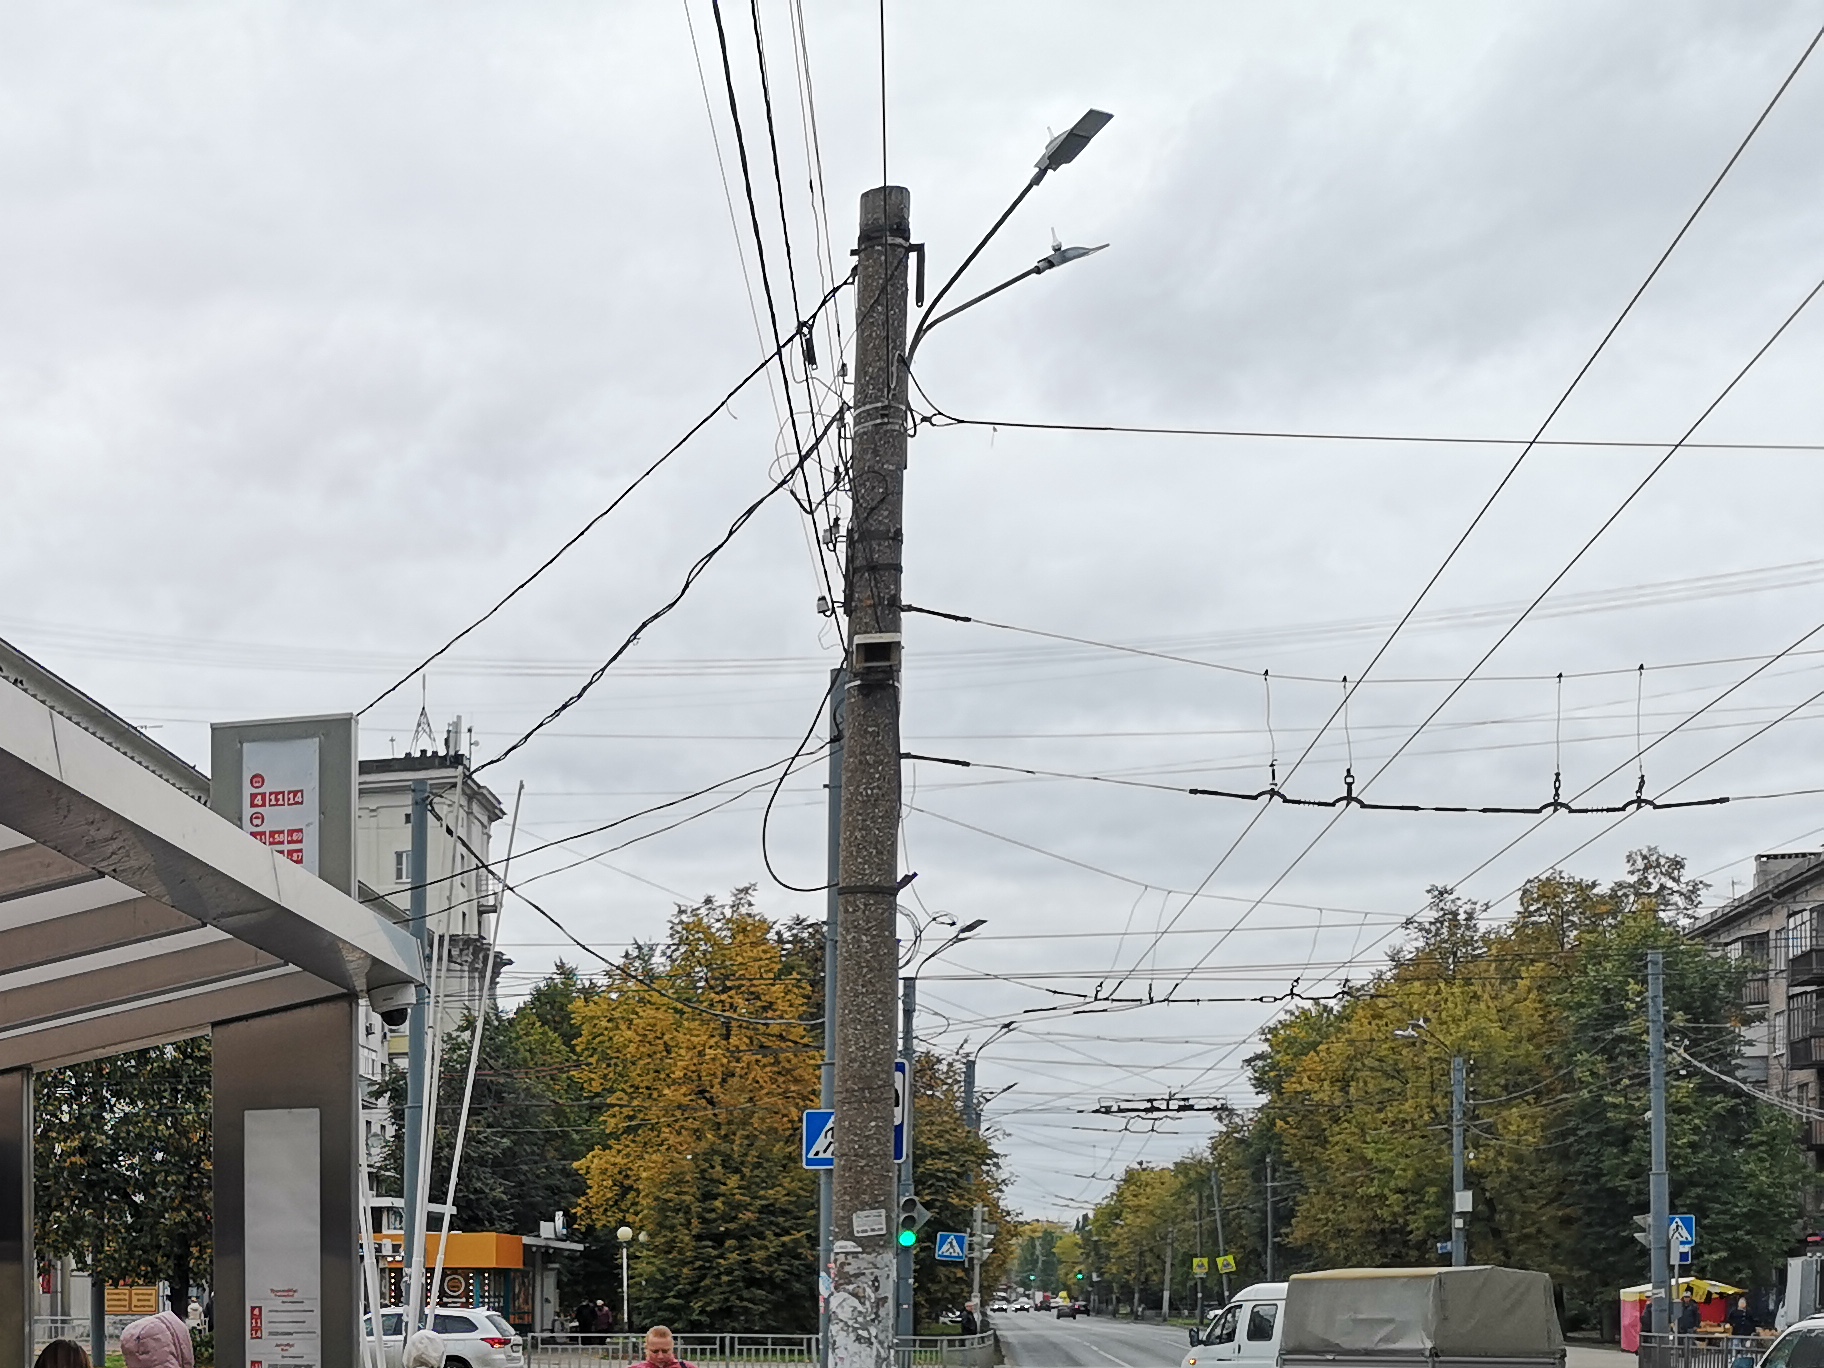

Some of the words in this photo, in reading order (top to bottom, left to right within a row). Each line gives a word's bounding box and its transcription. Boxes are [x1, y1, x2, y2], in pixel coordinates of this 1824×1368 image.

[254, 794, 263, 806] 4
[269, 793, 285, 806] 11
[288, 791, 303, 805] 14
